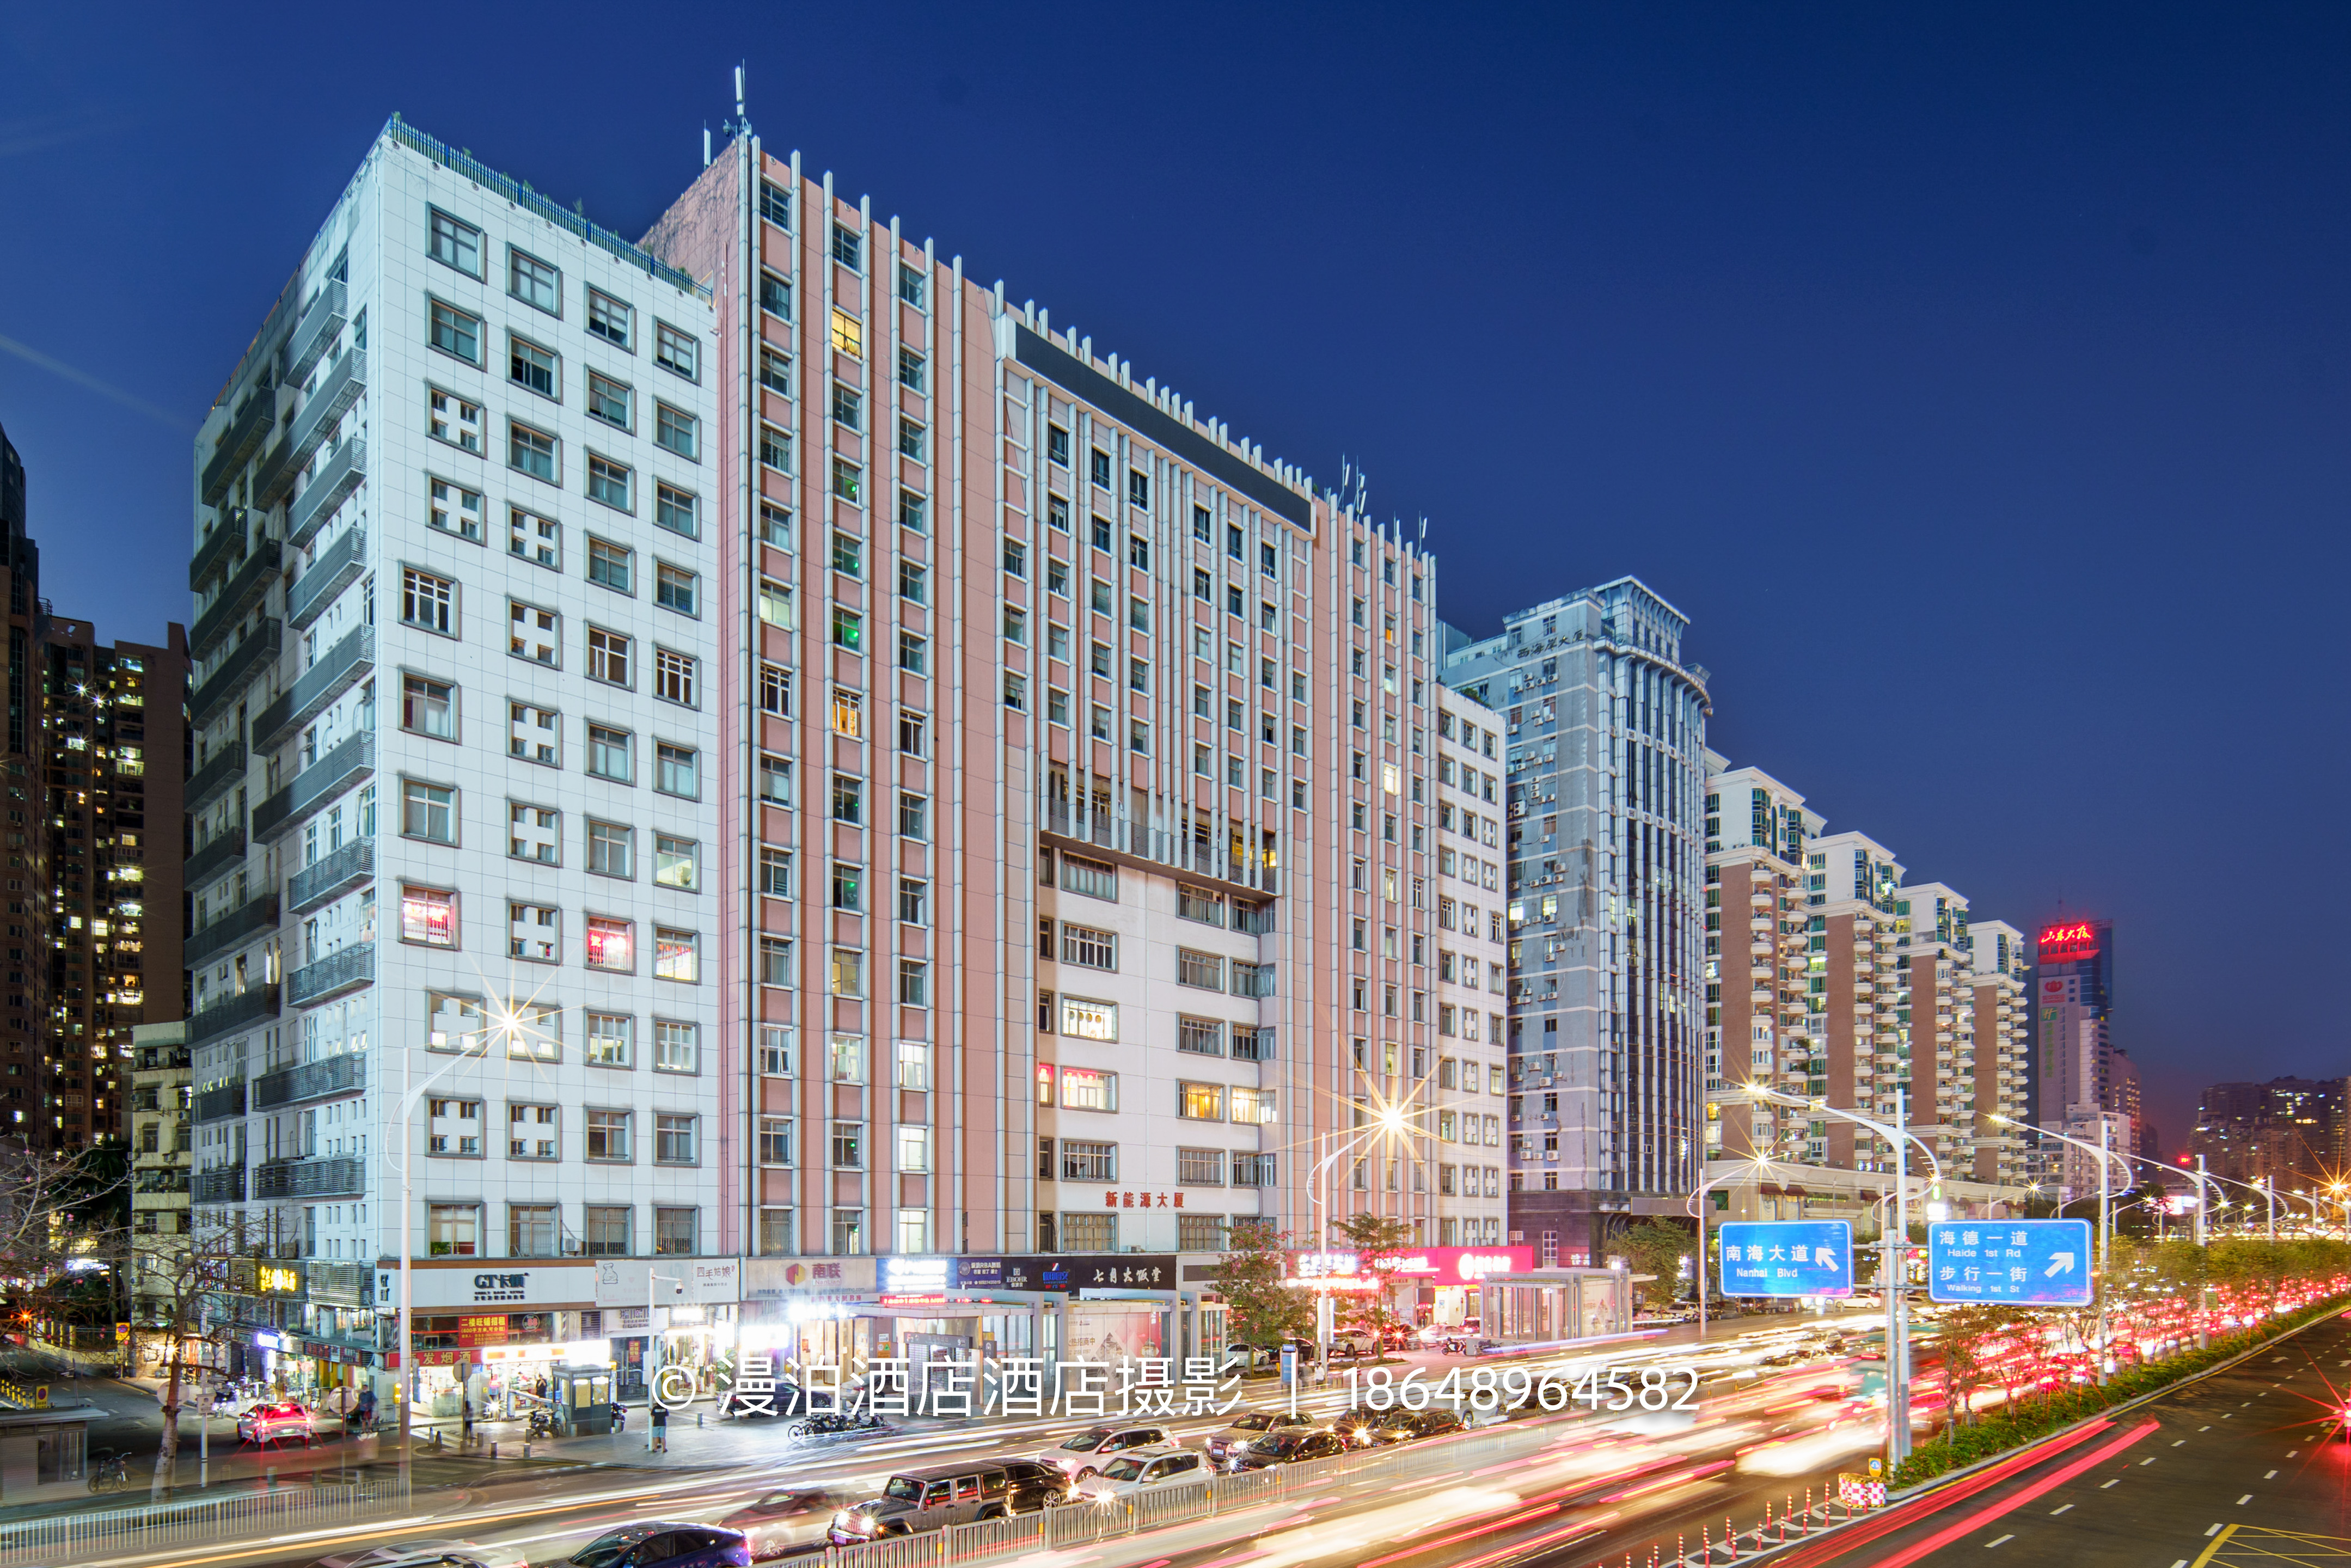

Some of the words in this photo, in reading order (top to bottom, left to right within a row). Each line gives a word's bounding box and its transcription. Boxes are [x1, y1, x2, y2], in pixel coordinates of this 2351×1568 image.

[1517, 629, 1585, 658] 西海岸大厦
[1106, 1191, 1184, 1208] 新能源大厦
[1939, 1230, 2028, 1246] 海德一道
[1726, 1245, 1809, 1261] 南海大道
[1948, 1249, 1977, 1257] Haide
[1985, 1249, 1998, 1257] 1st
[2006, 1249, 2021, 1257] Rd
[697, 1265, 731, 1280] 四毛姑娘
[812, 1263, 841, 1278] 南联
[1093, 1266, 1161, 1284] 七月大饭堂
[1737, 1268, 1767, 1277] Nanhai
[1777, 1268, 1798, 1277] Blvd
[1939, 1266, 2027, 1282] 步行一街
[1946, 1284, 1981, 1294] Walking
[461, 1316, 505, 1327] 二楼旺铺招租
